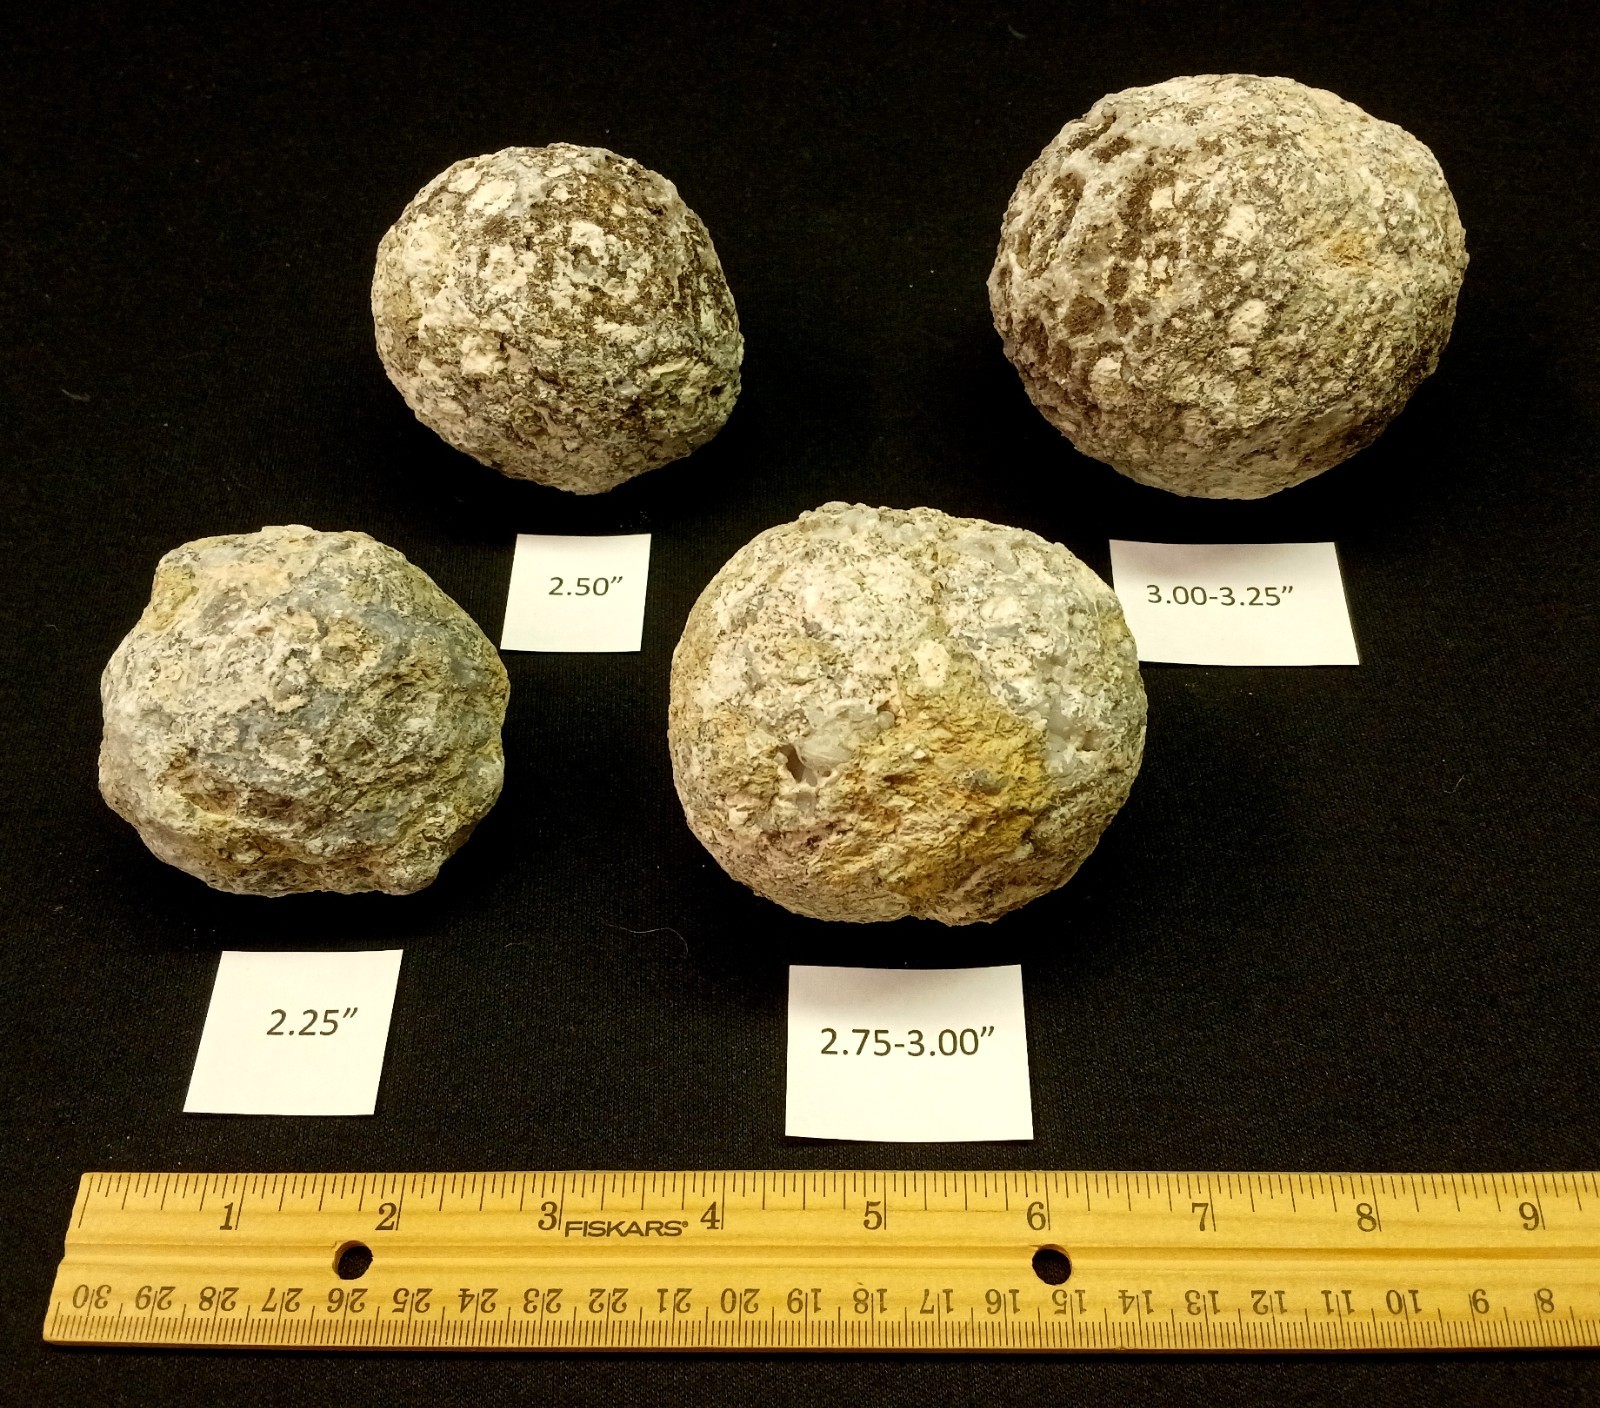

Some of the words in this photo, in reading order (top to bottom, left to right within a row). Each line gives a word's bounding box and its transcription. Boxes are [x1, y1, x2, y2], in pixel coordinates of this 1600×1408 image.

[548, 575, 623, 597] 2.50”
[266, 1006, 359, 1036] 2.25”
[220, 1202, 235, 1231] 1
[375, 1203, 397, 1231] 2
[538, 1201, 558, 1231] 3
[700, 1201, 720, 1230] 4
[863, 1201, 882, 1230] 5
[1026, 1201, 1046, 1231] 6
[1191, 1202, 1209, 1232] 7
[1355, 1202, 1377, 1232] 8
[1518, 1201, 1540, 1231] 9
[72, 1284, 112, 1310] 30
[135, 1286, 176, 1311] 29
[199, 1286, 239, 1312] 28
[262, 1287, 303, 1313] 27
[327, 1287, 368, 1313] 26
[392, 1287, 433, 1313] 25
[457, 1288, 499, 1314] 24
[523, 1287, 563, 1314] 23
[588, 1287, 629, 1314] 22
[656, 1287, 693, 1314] 21
[720, 1287, 761, 1314] 20
[786, 1287, 822, 1314] 19
[852, 1288, 888, 1314] 18
[919, 1288, 954, 1314] 17
[985, 1288, 1020, 1314] 16
[1051, 1288, 1087, 1315] 15
[1118, 1289, 1154, 1315] 14
[1184, 1289, 1221, 1315] 13
[1250, 1289, 1288, 1315] 12
[1320, 1289, 1355, 1315] 11
[1385, 1289, 1422, 1315] 10
[1472, 1288, 1490, 1314] 9
[1536, 1287, 1555, 1313] 8
